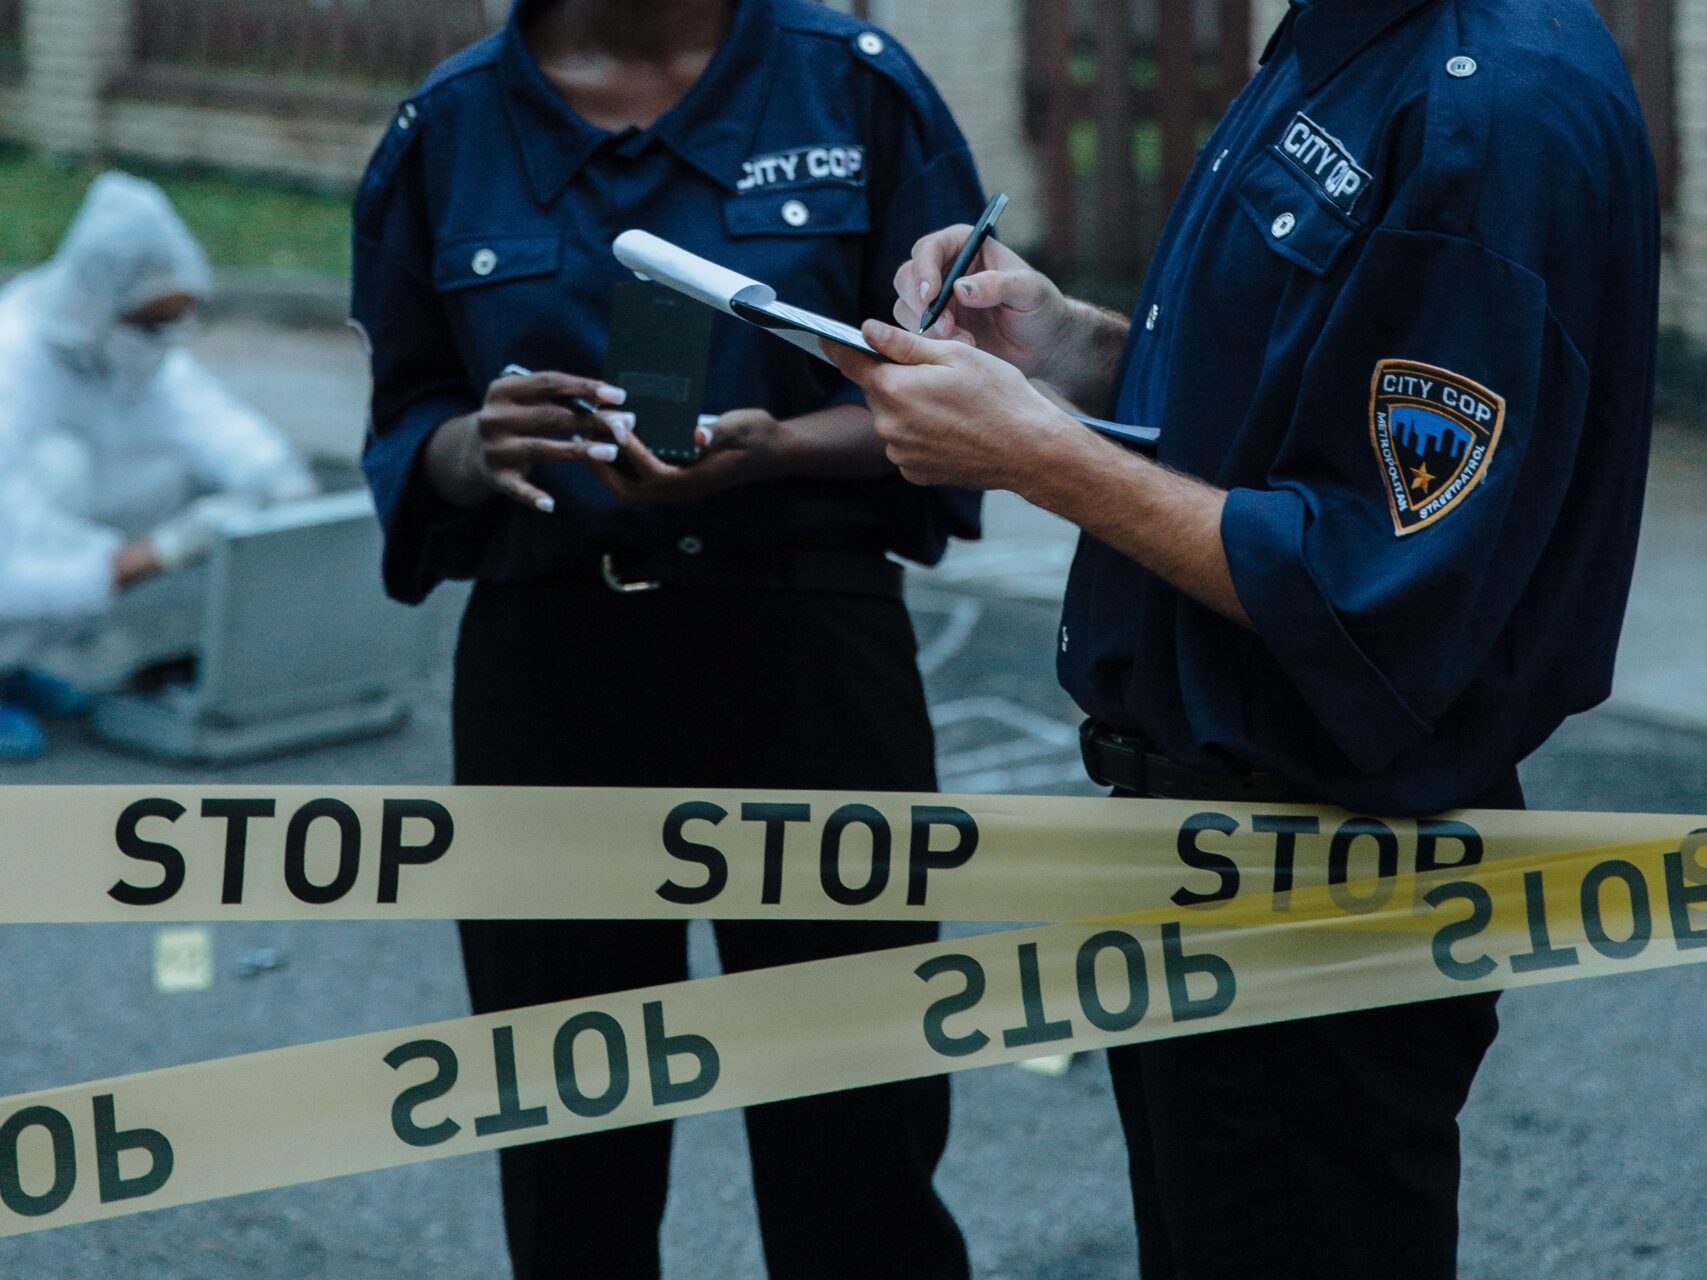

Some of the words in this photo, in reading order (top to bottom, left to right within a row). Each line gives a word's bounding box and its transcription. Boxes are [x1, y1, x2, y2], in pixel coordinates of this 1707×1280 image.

[1283, 122, 1337, 175] CITY
[1383, 374, 1434, 399] CITY
[1442, 387, 1491, 422] COP
[1376, 411, 1408, 512] METROPOLITAN
[107, 797, 455, 907] STOP
[655, 800, 979, 907] STOP
[1170, 812, 1484, 915] STOP
